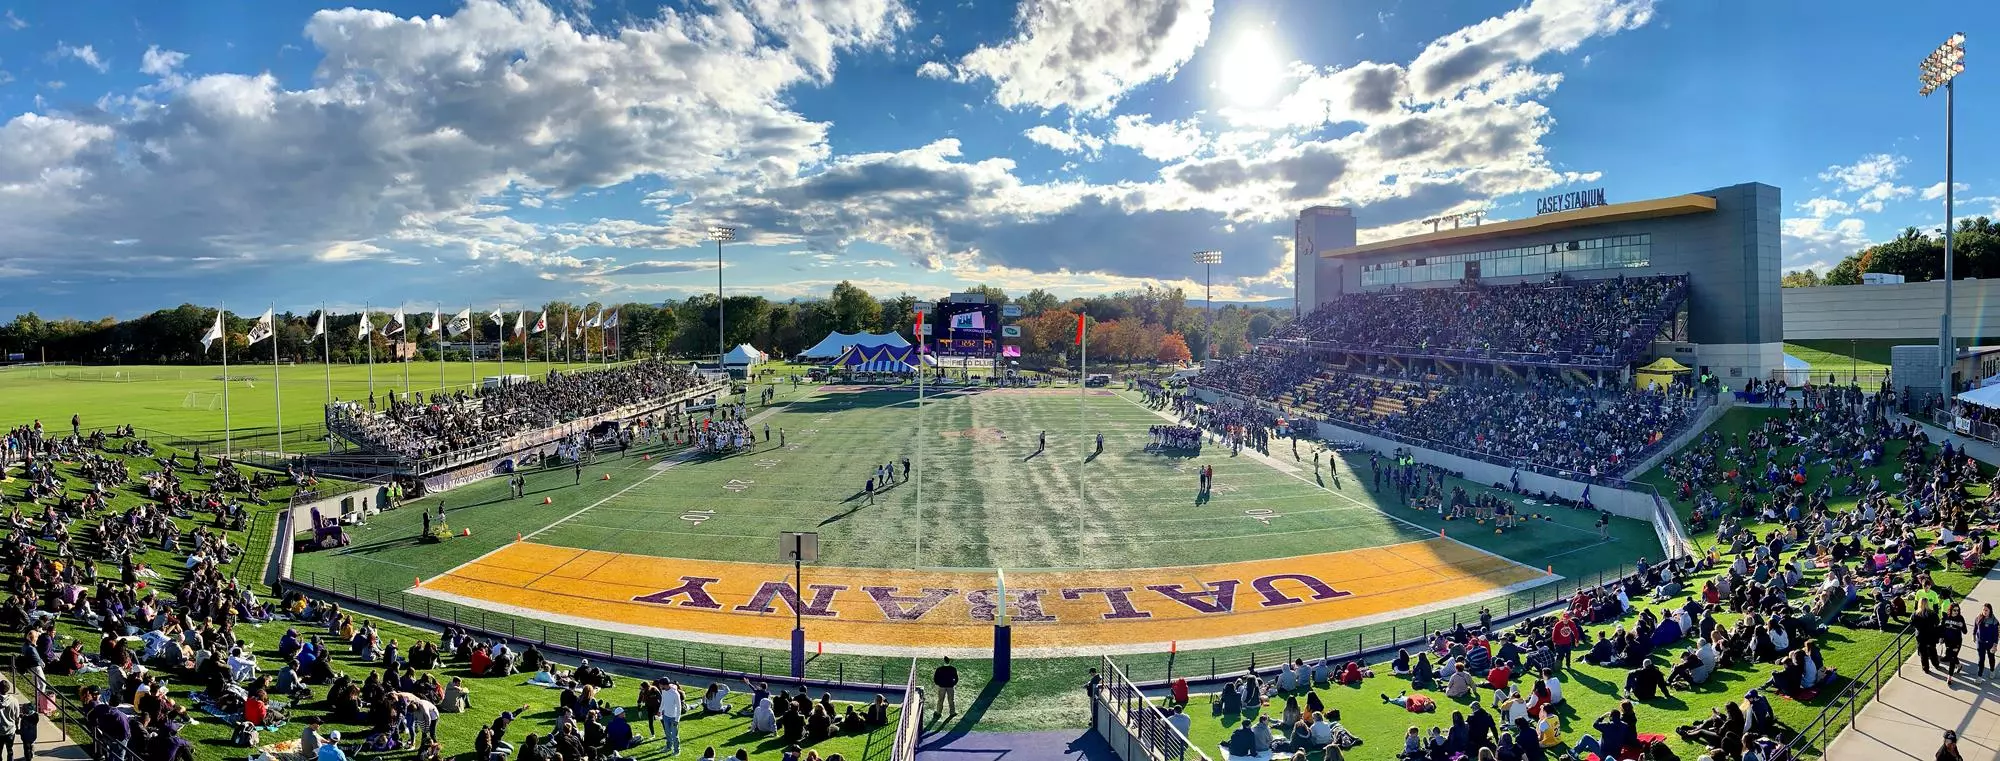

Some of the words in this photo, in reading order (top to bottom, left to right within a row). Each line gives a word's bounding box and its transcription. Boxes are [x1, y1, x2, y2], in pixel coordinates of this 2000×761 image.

[1537, 194, 1563, 214] CASEY
[1565, 188, 1605, 209] STADIUM
[632, 573, 1351, 624] UALBANY
